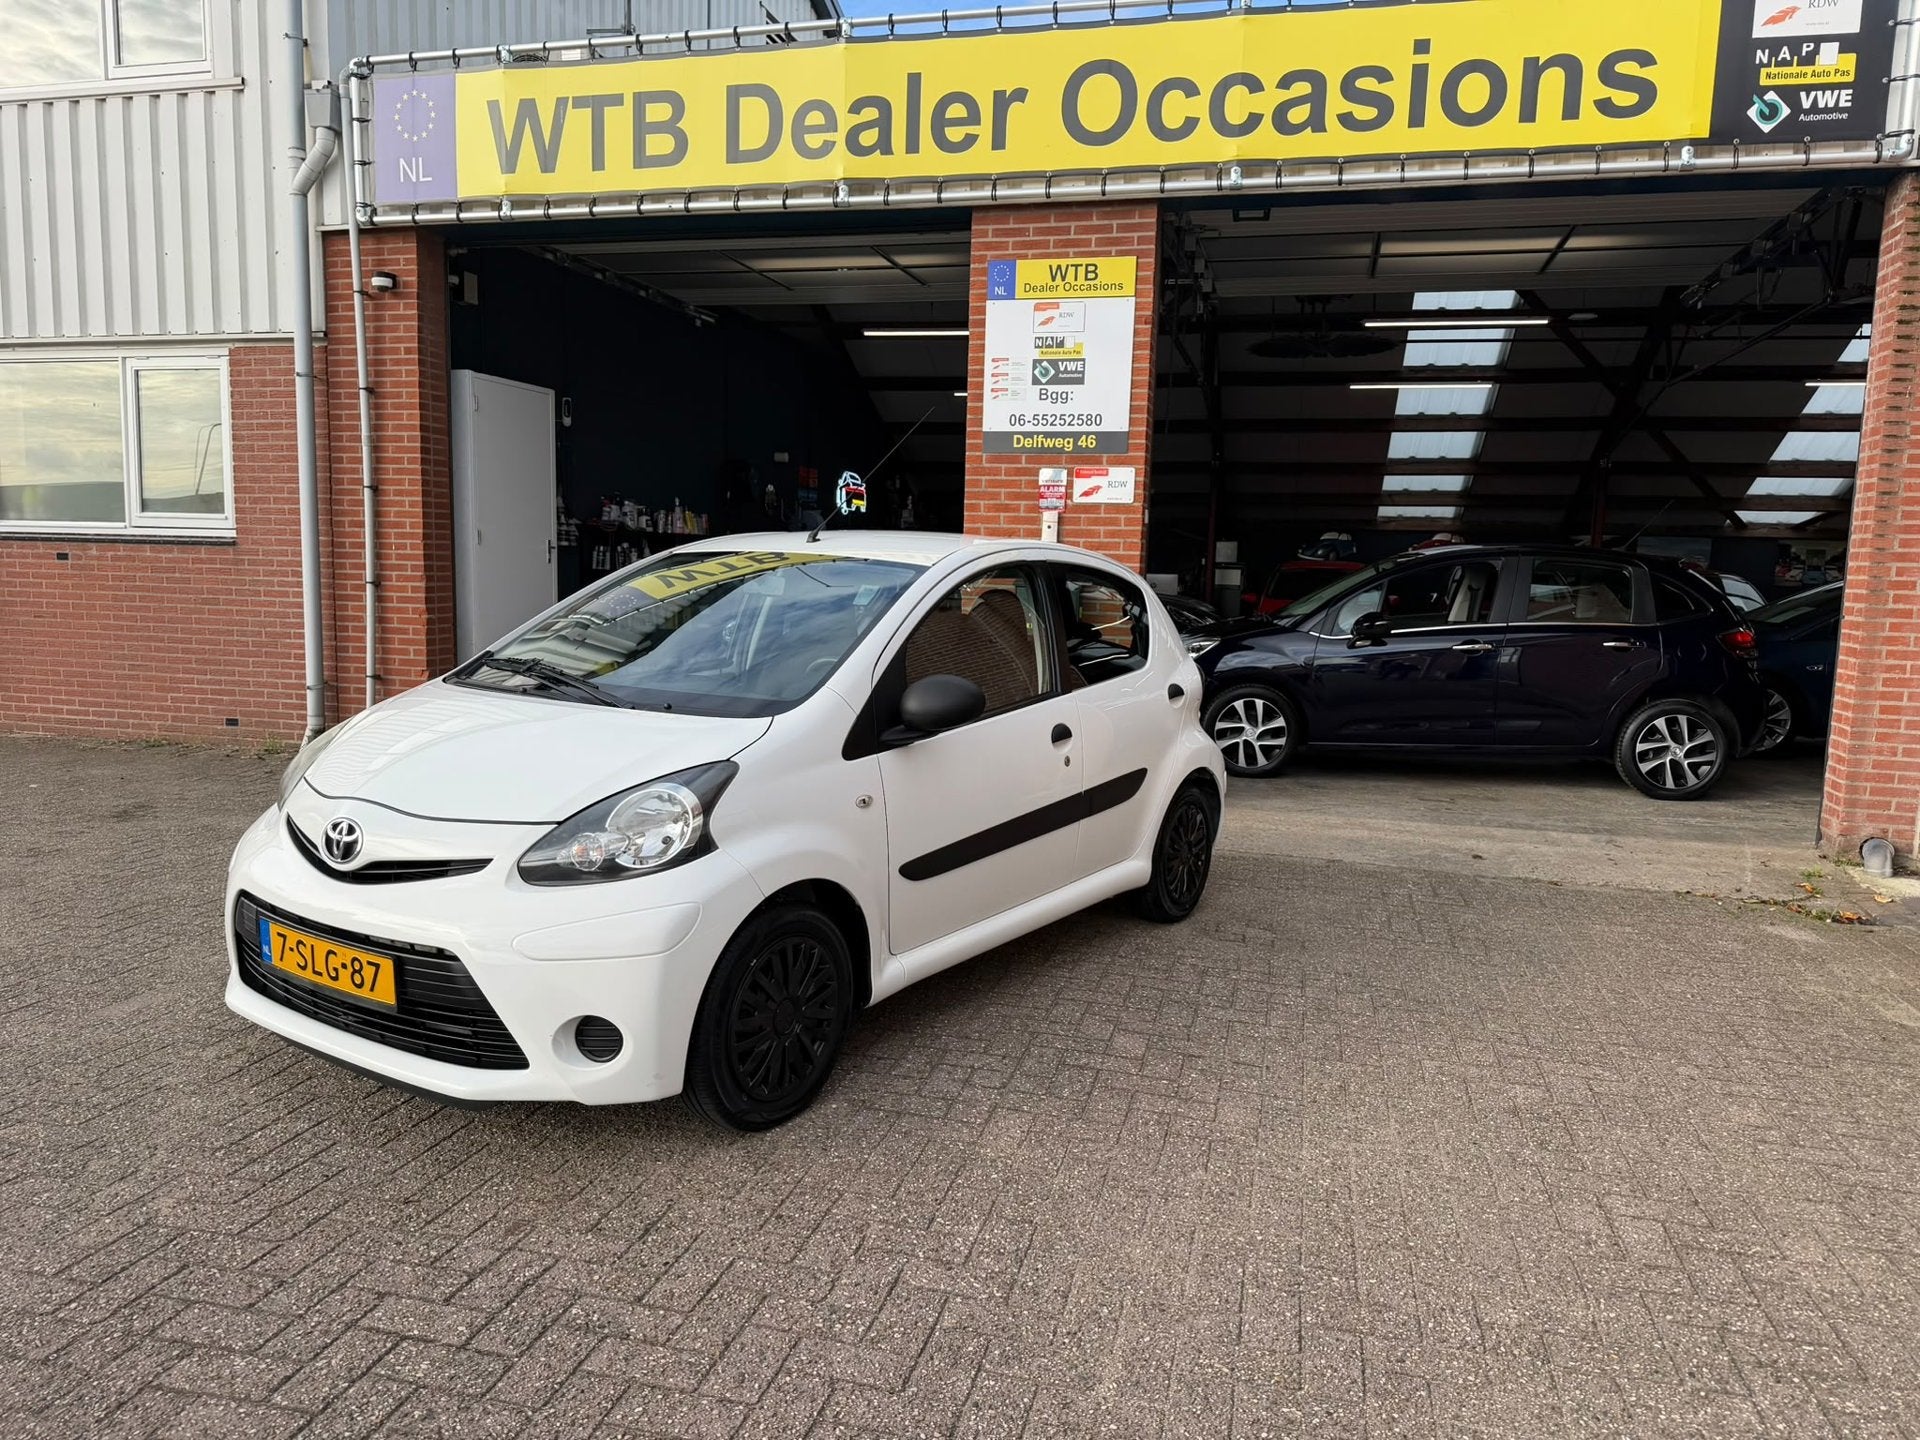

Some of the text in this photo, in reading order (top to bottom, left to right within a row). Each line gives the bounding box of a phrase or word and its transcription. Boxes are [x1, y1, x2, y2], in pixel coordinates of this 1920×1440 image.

[1765, 68, 1850, 80] Nationale Auto Pas
[487, 38, 1658, 175] WTB Dealer Occasions
[1800, 89, 1853, 109] VWE
[1799, 113, 1848, 121] Automotive
[399, 158, 432, 182] NL
[1049, 263, 1098, 282] WTB
[994, 286, 1007, 295] NL
[1024, 281, 1123, 293] Dealer Occasions
[1058, 361, 1084, 371] VWE
[1039, 388, 1074, 404] Bgg:
[1009, 413, 1103, 427] 06-55252580
[1013, 434, 1096, 451] Delfweg 46
[1107, 480, 1128, 488] RDW
[276, 931, 381, 993] 7-SLG-87
